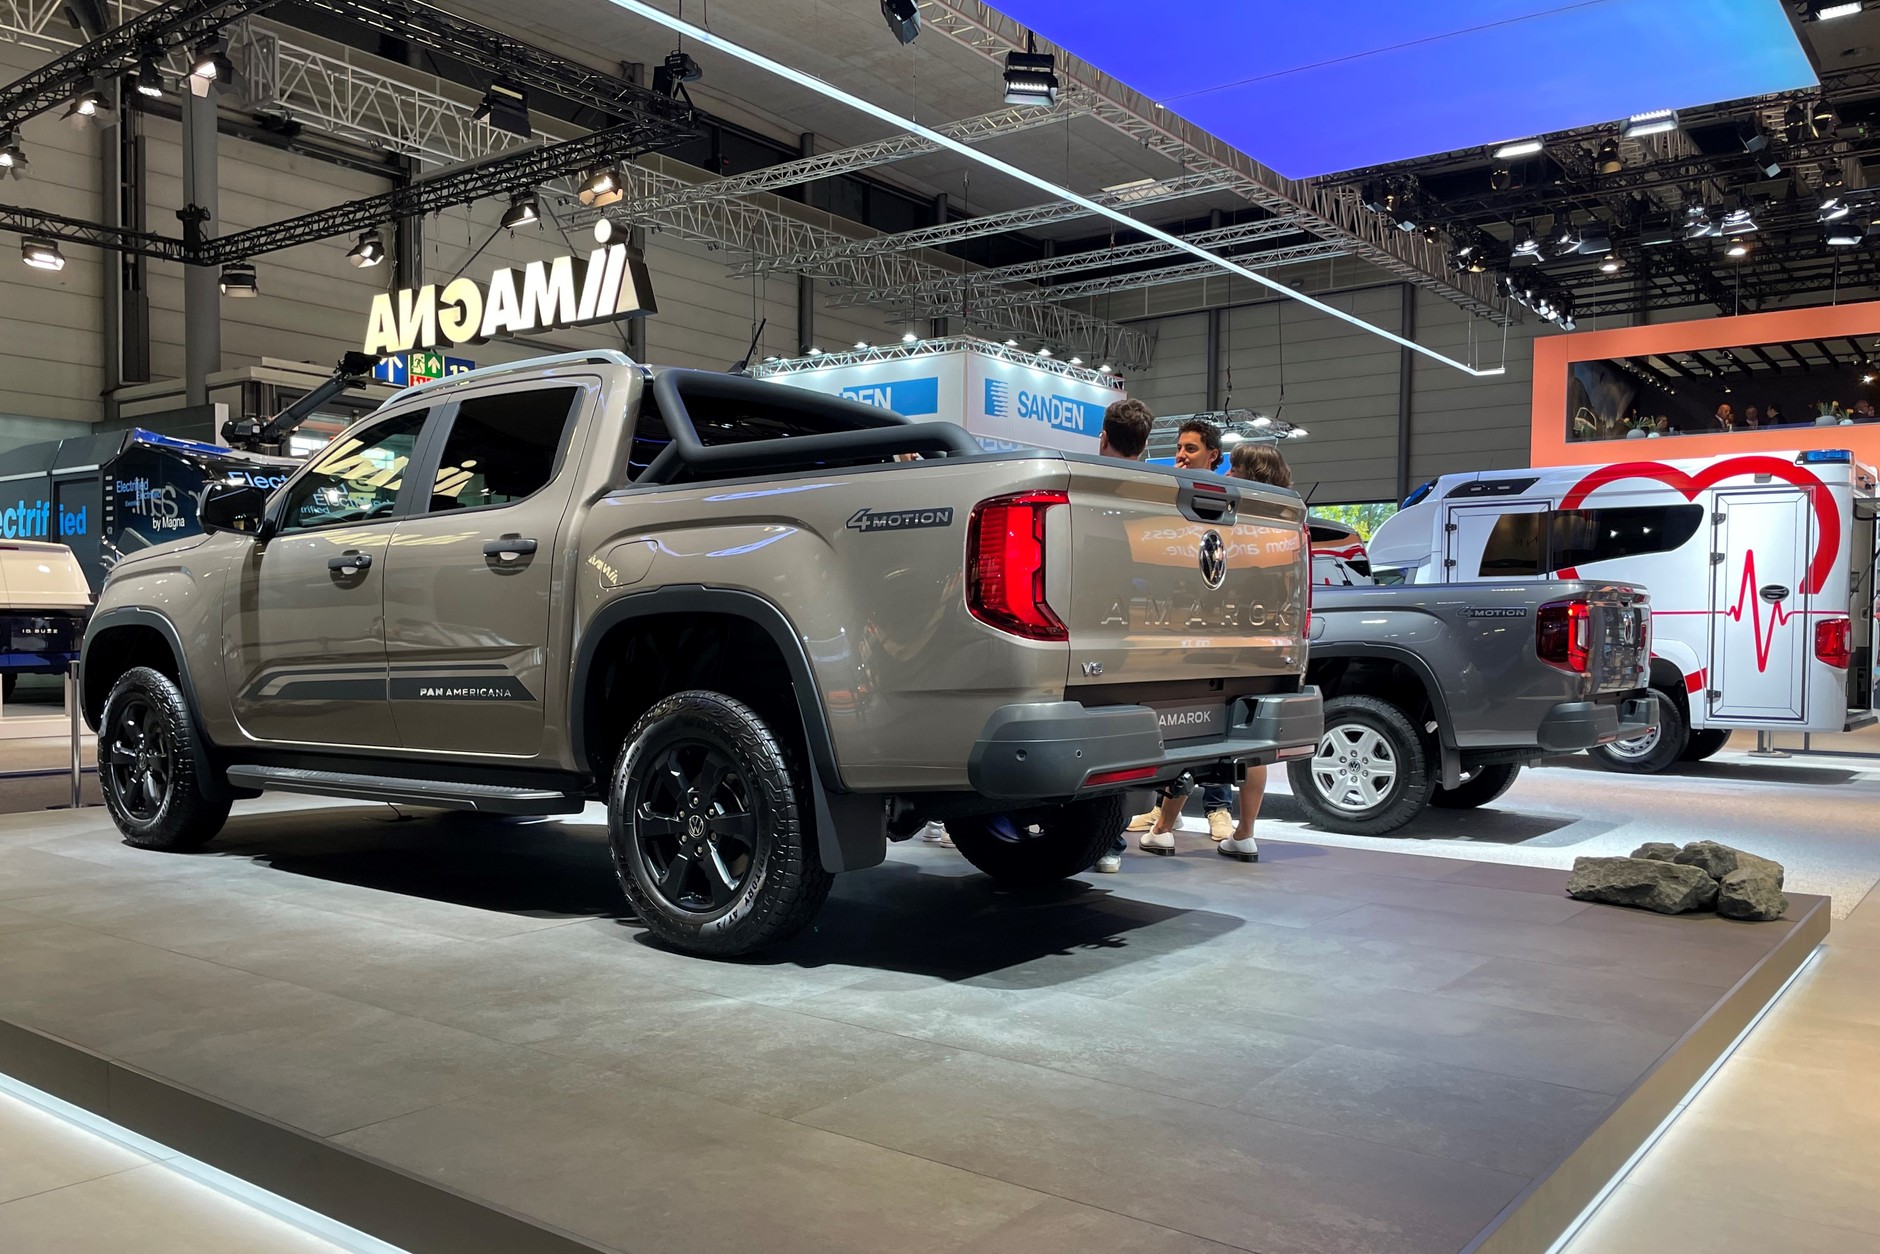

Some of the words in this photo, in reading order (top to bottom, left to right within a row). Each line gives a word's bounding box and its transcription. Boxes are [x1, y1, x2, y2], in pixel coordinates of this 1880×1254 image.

[1017, 390, 1085, 430] SANDEN
[0, 500, 87, 539] ctrified
[152, 517, 161, 532] by
[162, 516, 185, 530] Magna
[846, 507, 950, 531] 4MOTION
[1100, 598, 1293, 626] AMAROK
[1456, 605, 1526, 618] 4MOTION
[1158, 710, 1211, 726] AMAROK
